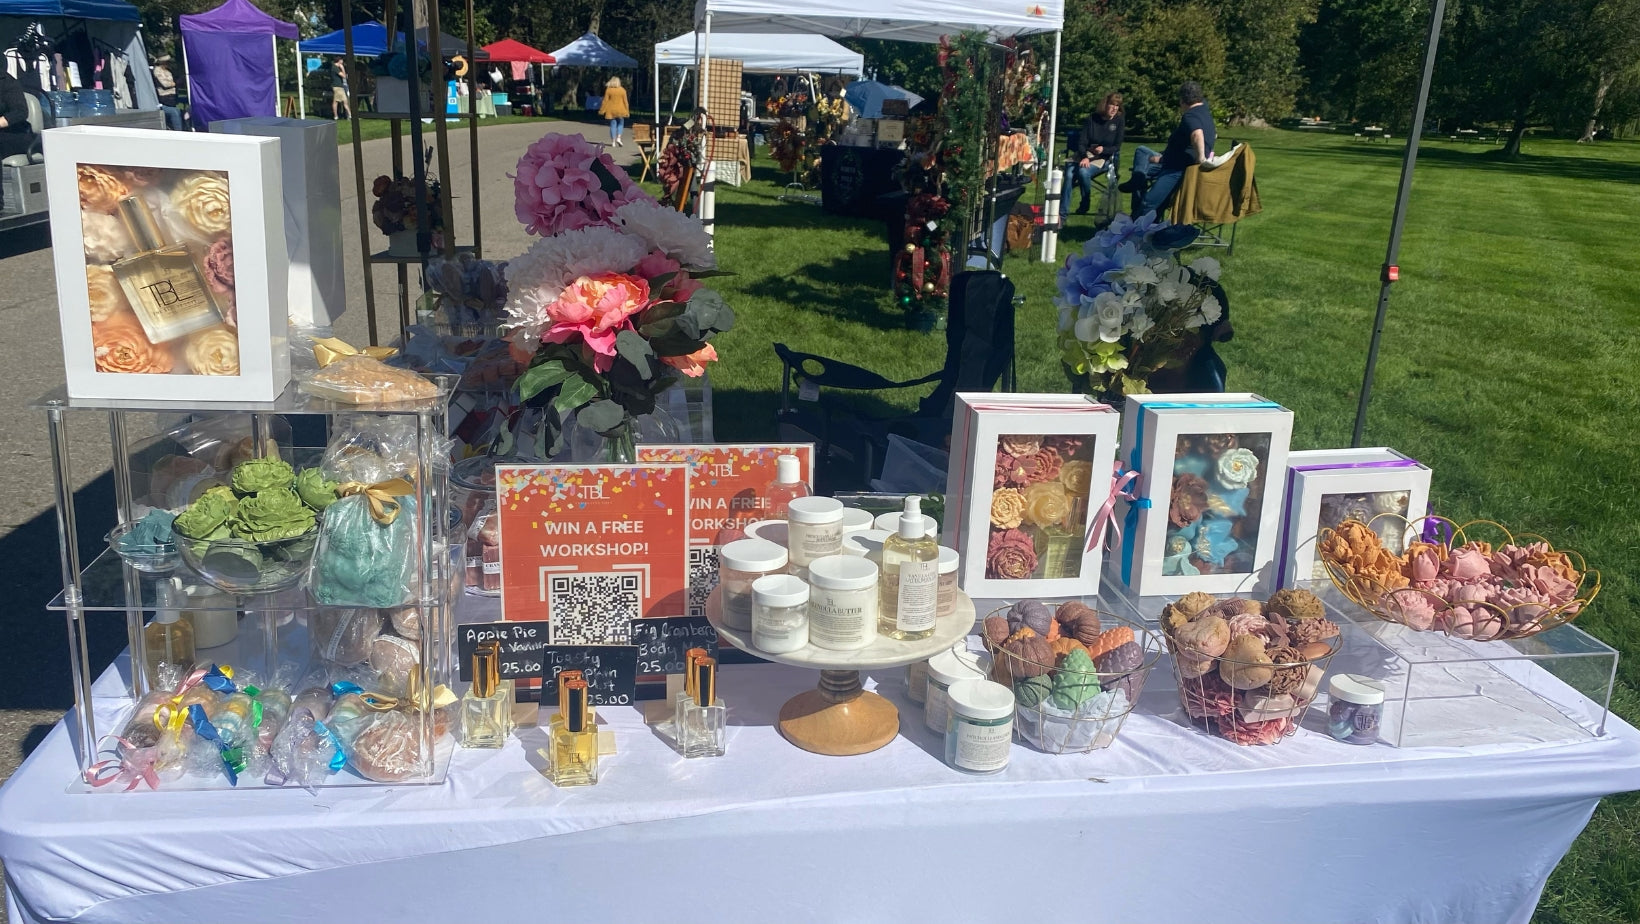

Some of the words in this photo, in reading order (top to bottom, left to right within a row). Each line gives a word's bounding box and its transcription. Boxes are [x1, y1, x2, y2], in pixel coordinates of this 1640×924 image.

[140, 280, 194, 307] TBL
[711, 463, 740, 477] TBL
[578, 485, 611, 499] TBL
[690, 497, 712, 509] IN
[716, 497, 727, 509] A
[544, 521, 580, 535] WIN
[584, 521, 598, 534] A
[601, 520, 644, 534] FREE
[540, 542, 649, 557] WORKSHOP!
[466, 628, 508, 643] Apple
[512, 626, 537, 639] Pie
[633, 623, 658, 640] Fig
[639, 642, 678, 661] Body
[502, 661, 541, 674] 25.00
[640, 660, 686, 673] 25.00
